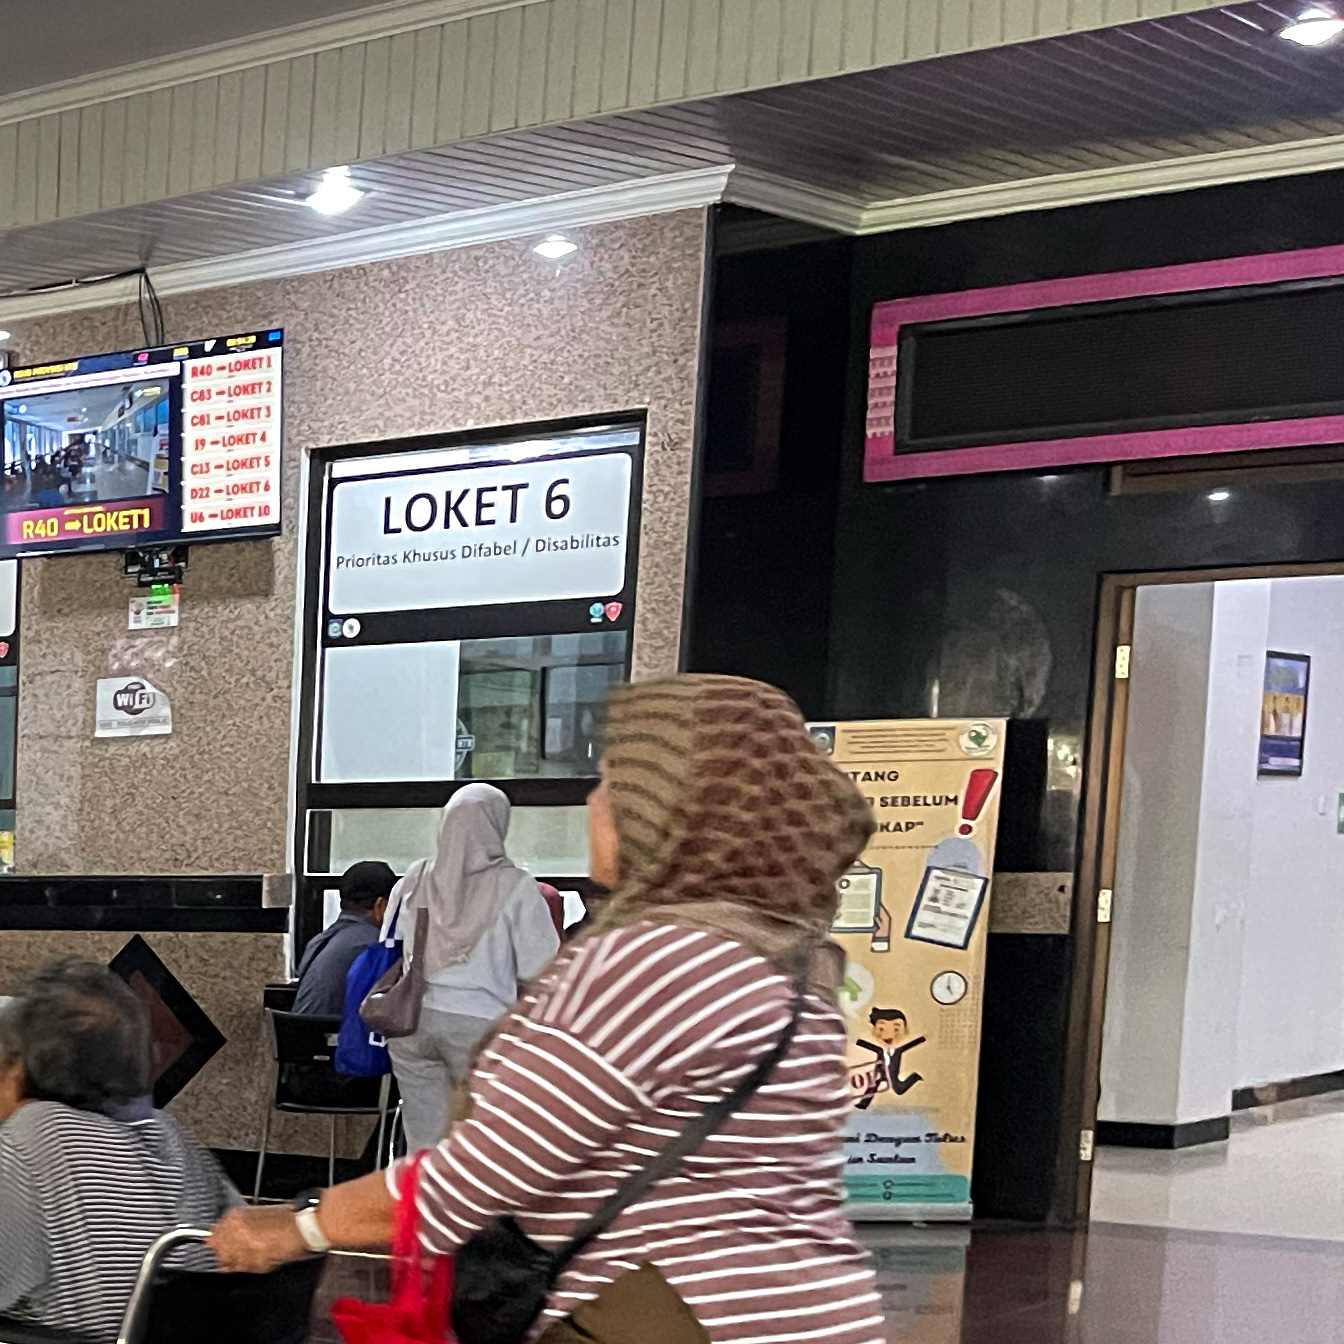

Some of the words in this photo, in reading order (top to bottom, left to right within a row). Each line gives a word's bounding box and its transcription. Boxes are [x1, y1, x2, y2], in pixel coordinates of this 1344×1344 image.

[228, 356, 264, 373] LOKET
[266, 355, 272, 368] 1
[227, 382, 264, 398] LOKET
[266, 380, 272, 393] 2
[226, 406, 263, 422] LOKET
[222, 432, 257, 448] LOKET
[226, 456, 261, 471] LOKET
[264, 455, 271, 467] 5
[226, 481, 261, 496] LOKET
[220, 506, 255, 521] LOKET
[383, 482, 529, 535] LOKET
[544, 478, 570, 521] 6
[22, 517, 59, 540] R40
[336, 551, 398, 569] Prioritas
[402, 546, 457, 564] Khusus
[461, 542, 518, 560] Difabel
[520, 537, 531, 557] /
[535, 533, 620, 554] Disabilitas
[849, 770, 900, 783] TANG
[879, 795, 959, 808] SEBELUM
